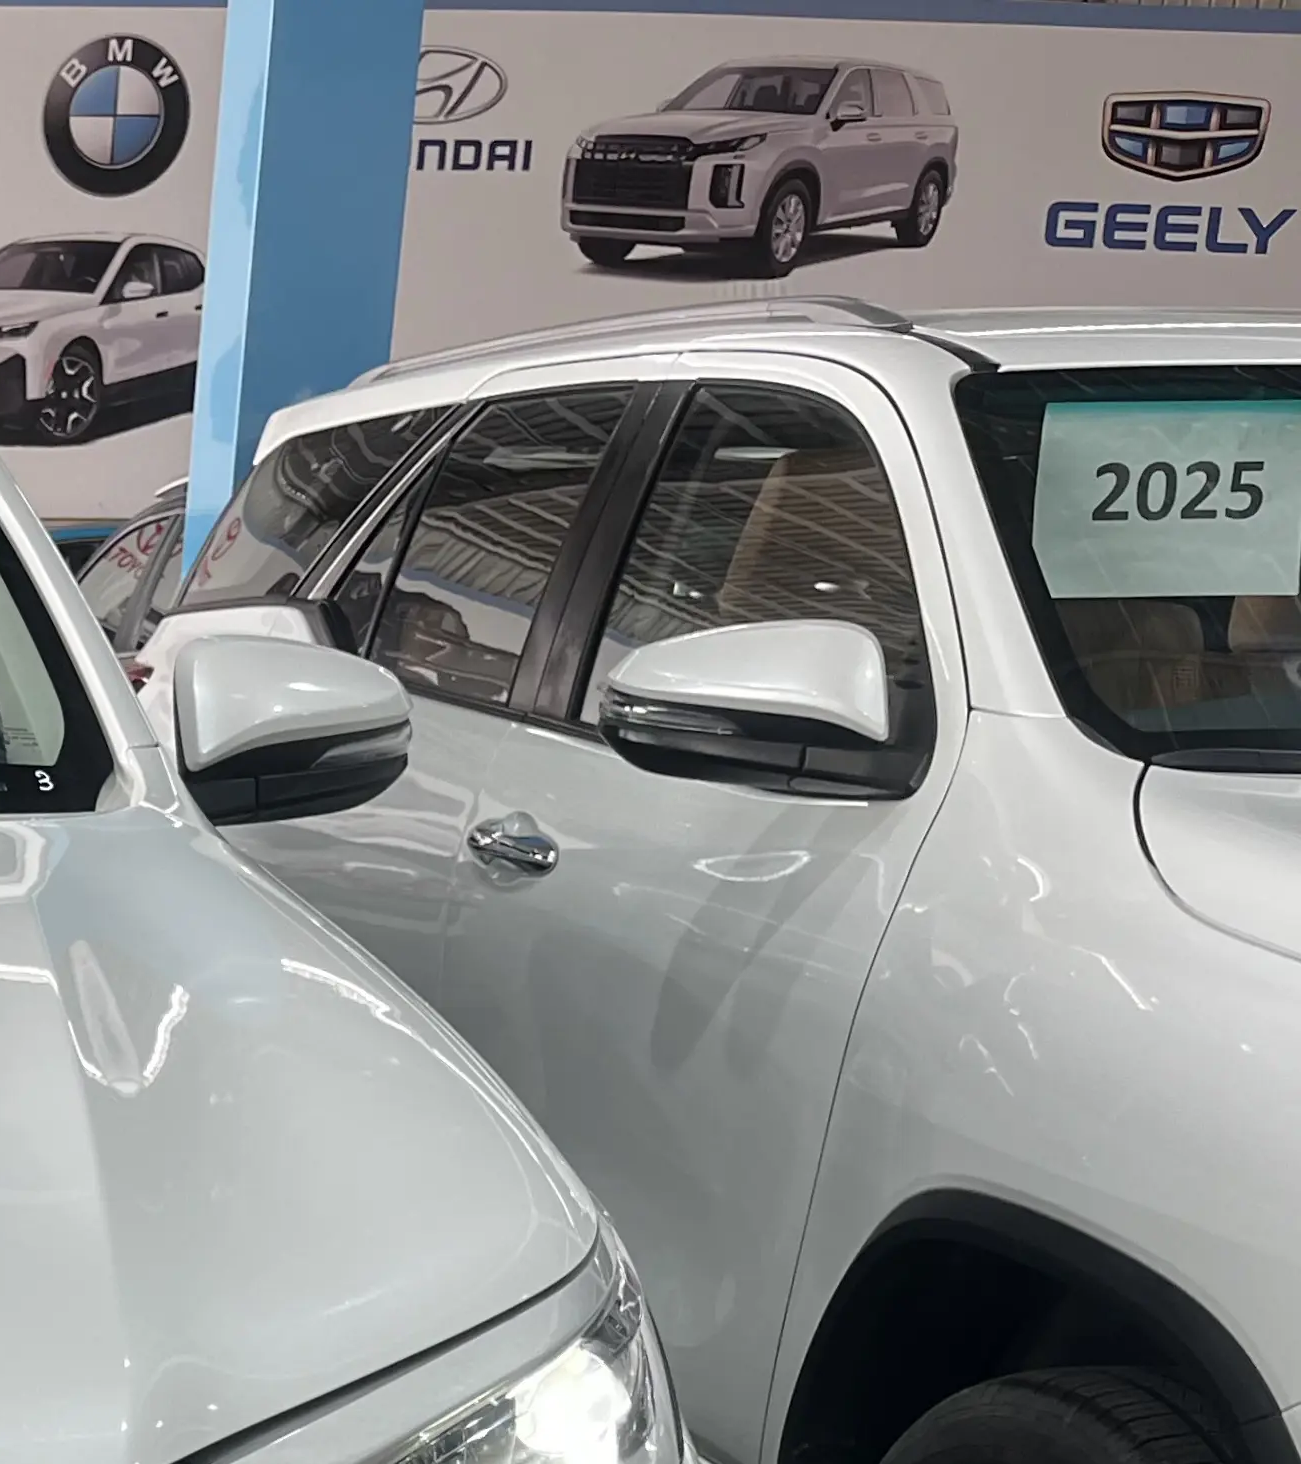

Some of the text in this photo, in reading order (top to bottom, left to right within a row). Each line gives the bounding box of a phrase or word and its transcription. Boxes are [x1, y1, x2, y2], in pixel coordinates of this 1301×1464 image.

[59, 37, 180, 89] BMW
[415, 138, 534, 172] NDAI
[1044, 200, 1298, 255] GEELY
[1090, 460, 1266, 522] 2025
